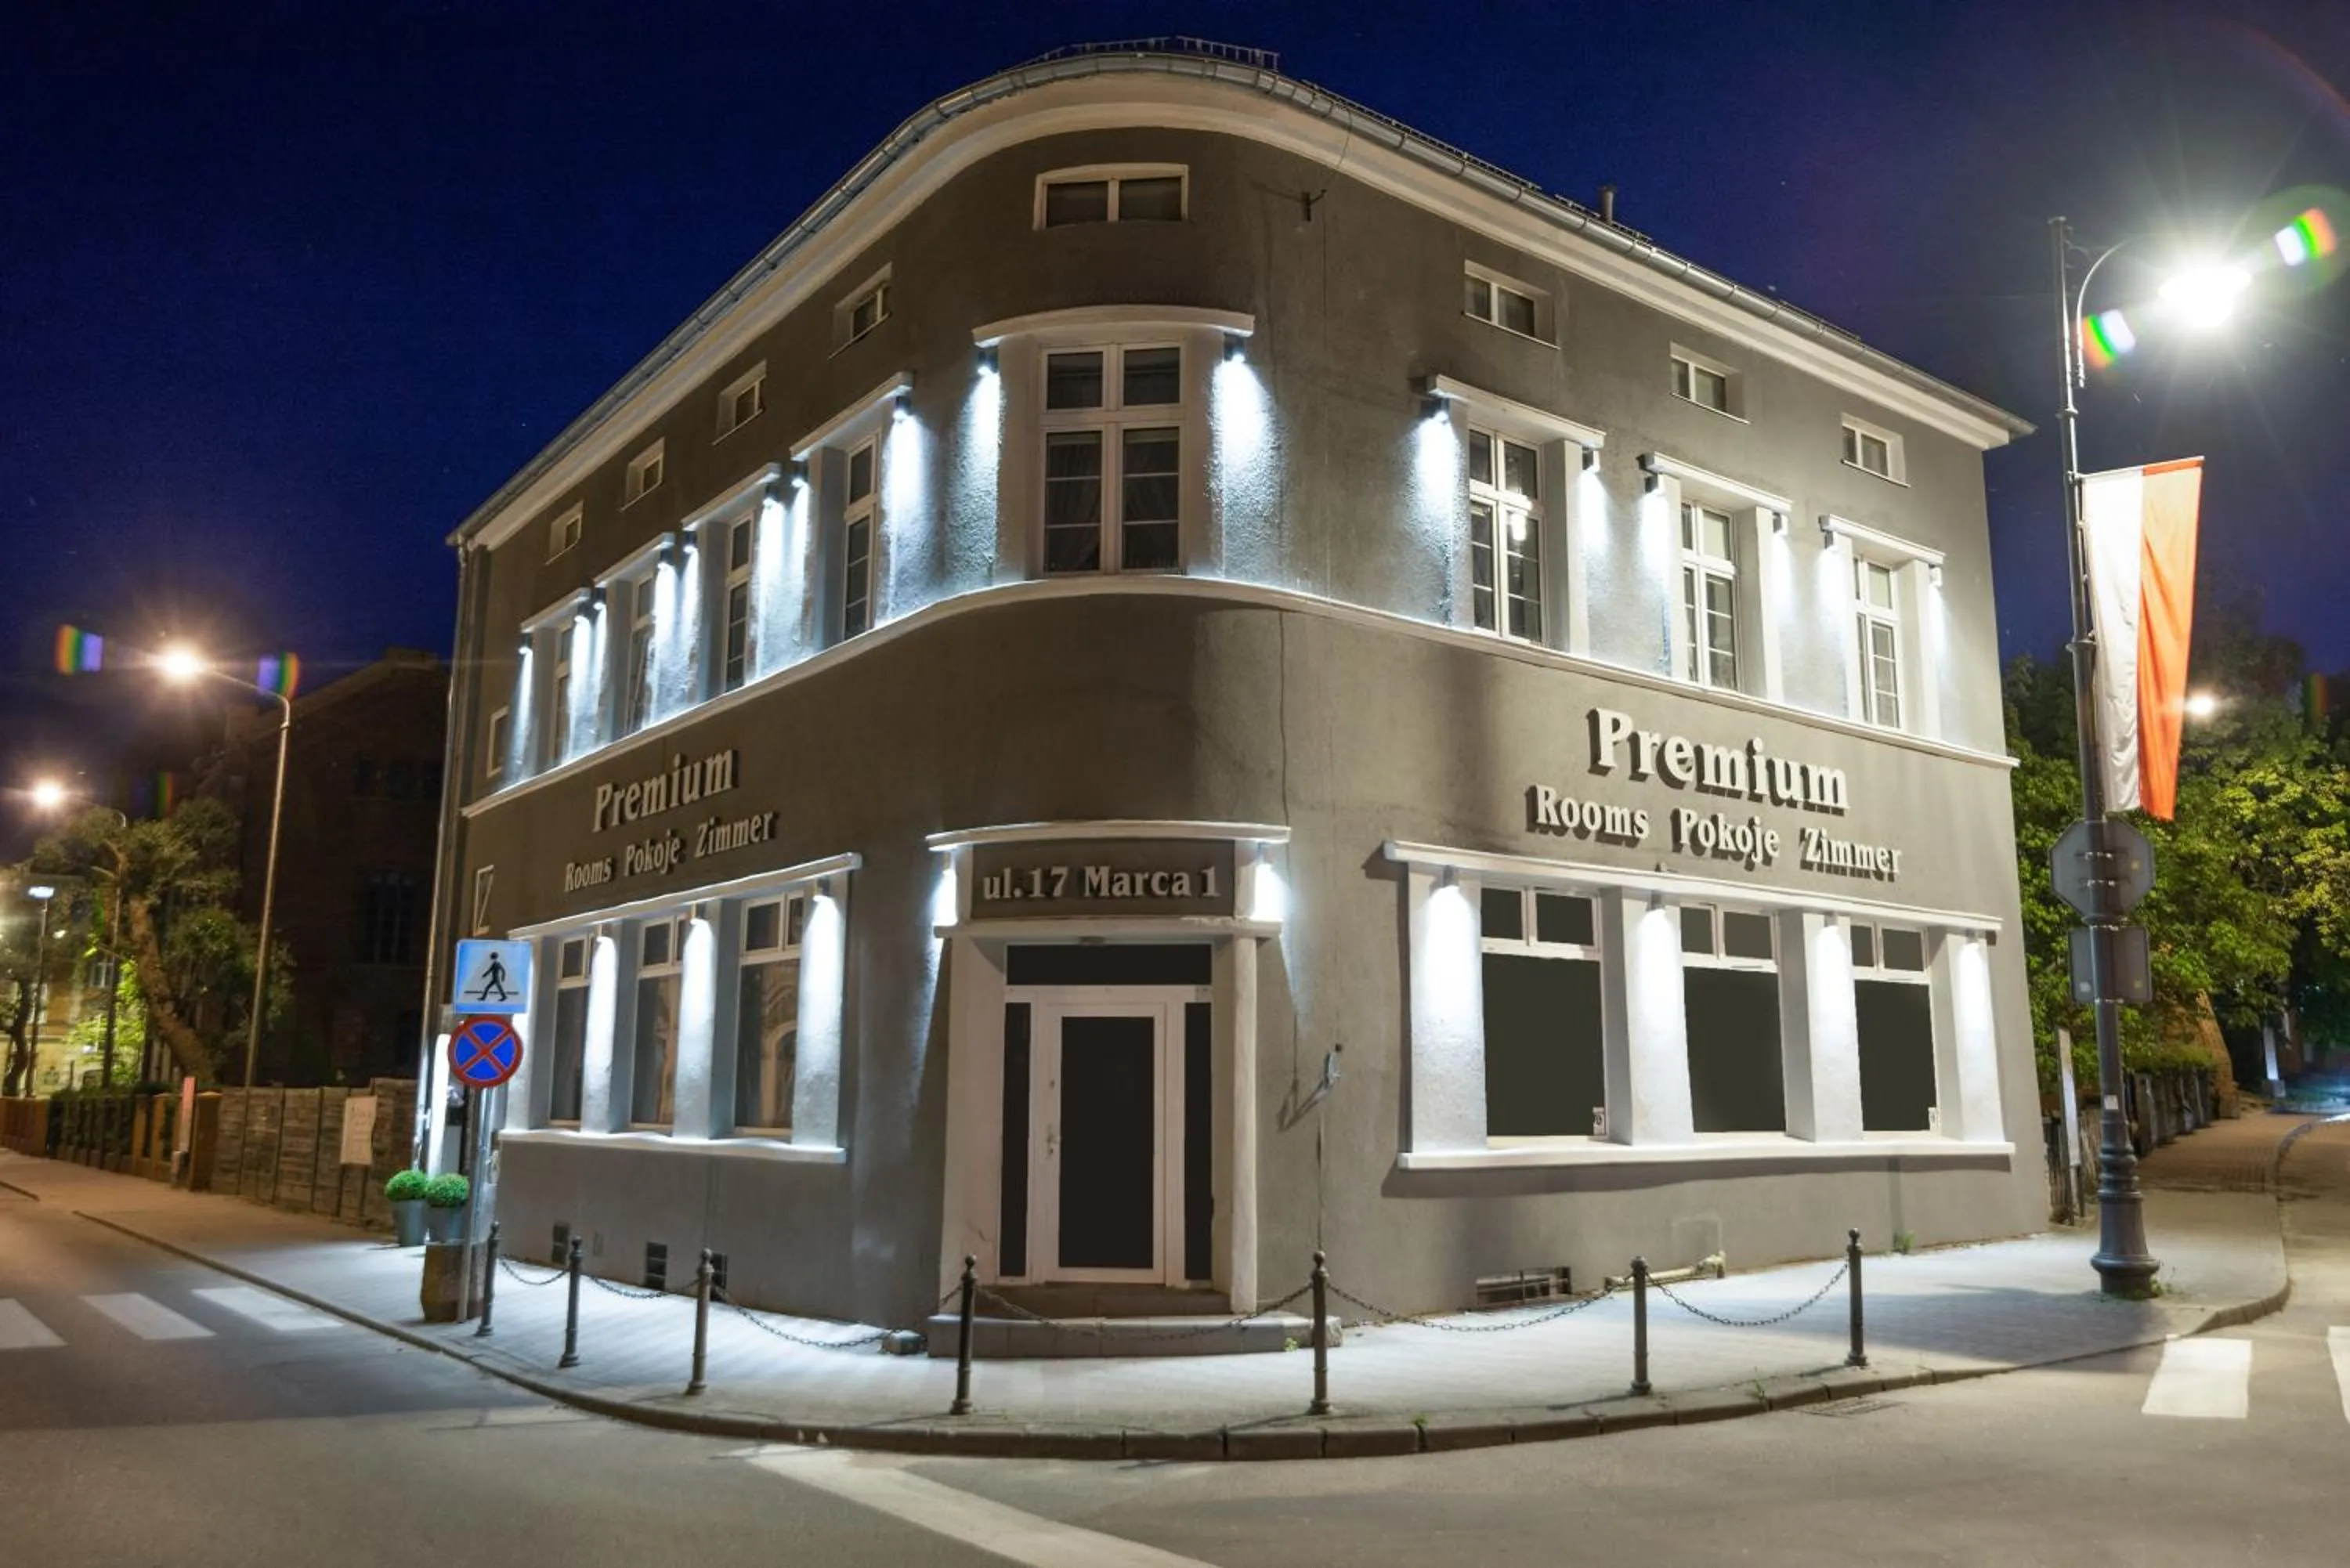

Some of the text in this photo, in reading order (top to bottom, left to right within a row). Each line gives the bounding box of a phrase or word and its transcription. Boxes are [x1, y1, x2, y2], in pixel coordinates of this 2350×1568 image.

[593, 749, 733, 833] Premium
[1593, 707, 1850, 810] Premium
[564, 811, 773, 892] Rooms Pokoje Zimmer
[1534, 784, 1902, 874] Rooms Pokoje Zimmer
[1083, 865, 1191, 898] Marca
[1201, 866, 1220, 898] 1
